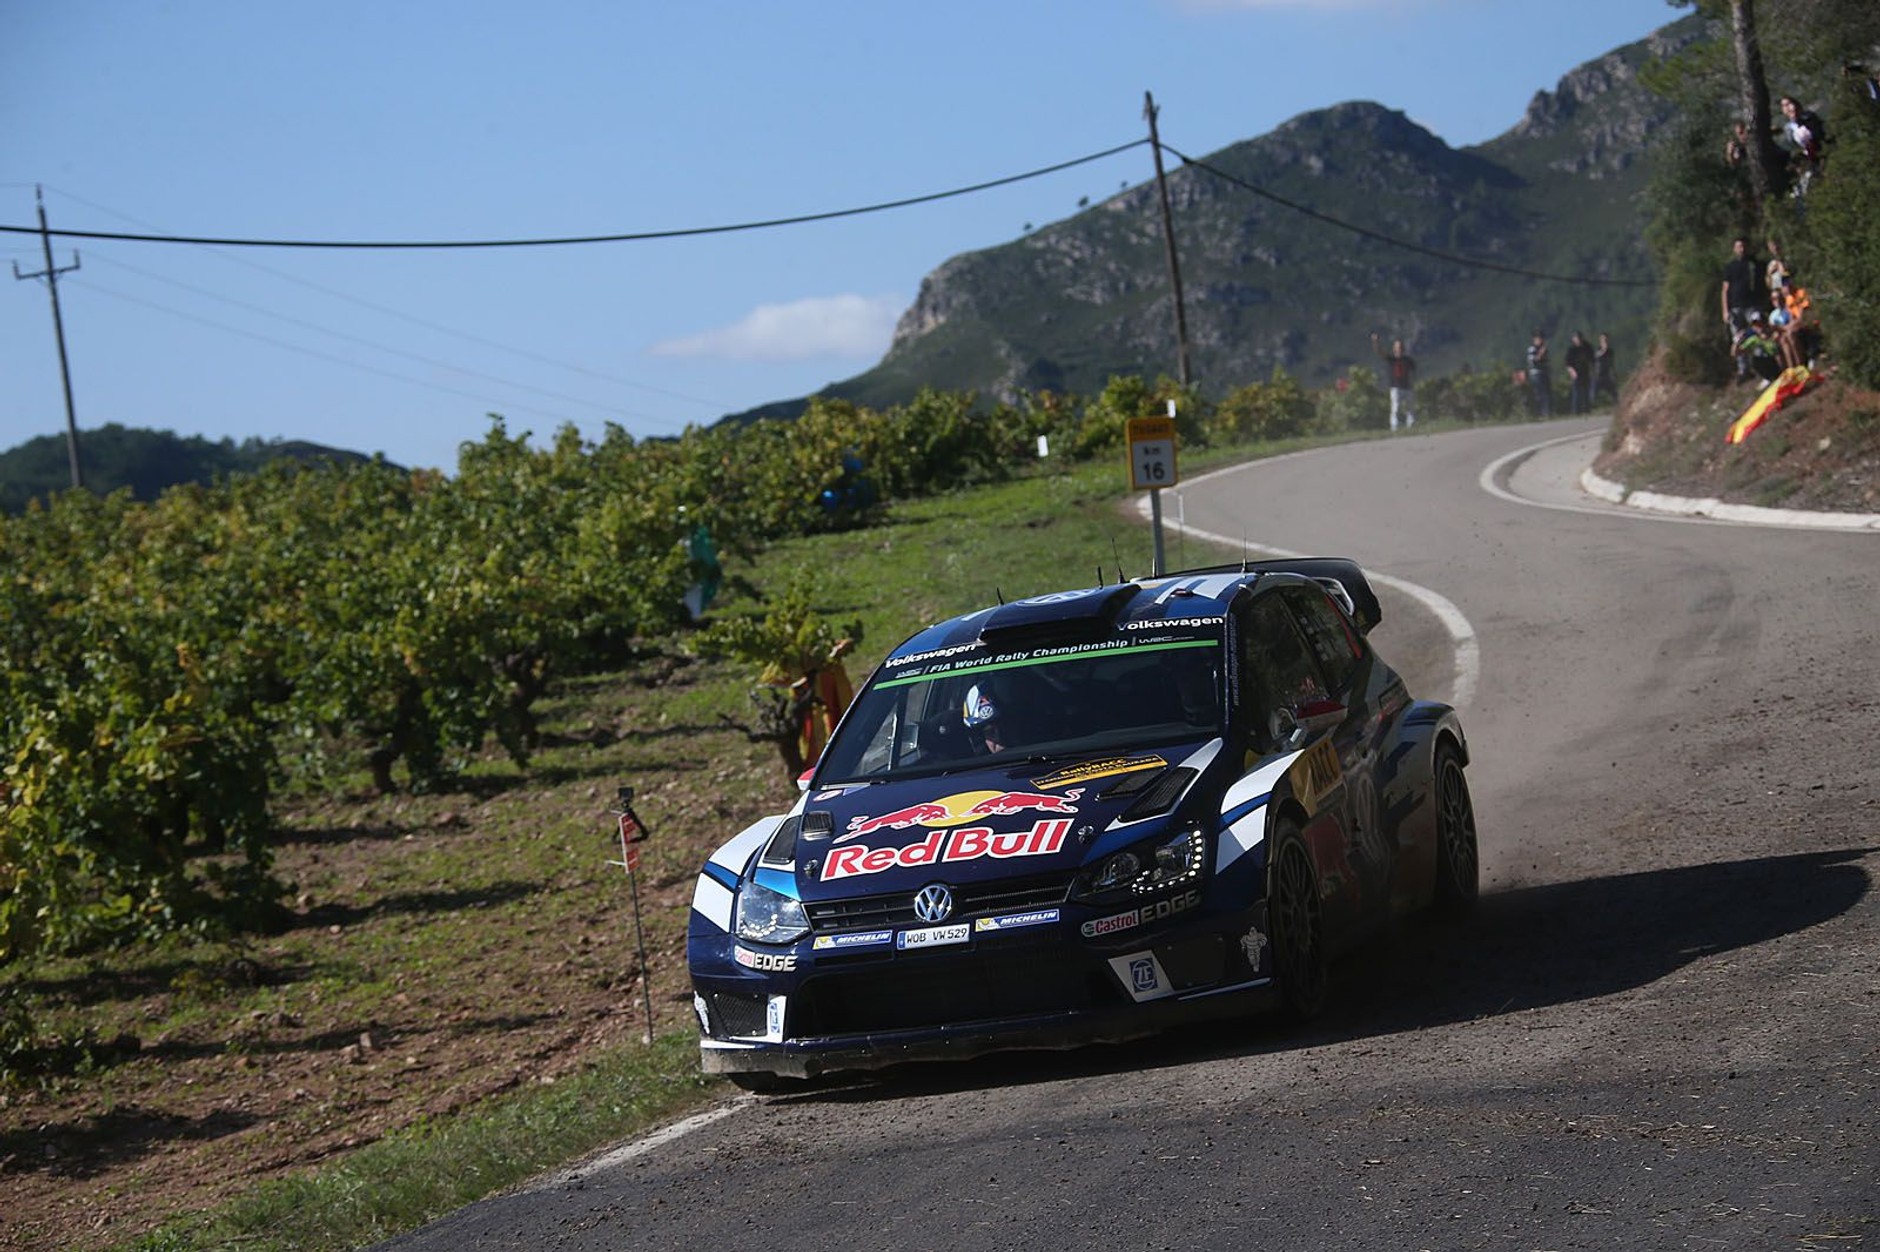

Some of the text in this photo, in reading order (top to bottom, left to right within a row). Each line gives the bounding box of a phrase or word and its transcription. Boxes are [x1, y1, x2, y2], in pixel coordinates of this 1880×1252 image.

[1143, 462, 1165, 481] 16
[1117, 617, 1224, 631] Volkswagen
[885, 644, 976, 669] Volkswagen
[930, 662, 951, 673] FIA
[955, 655, 992, 669] World
[995, 651, 1029, 663] Rally
[1032, 639, 1128, 657] Championship
[822, 819, 1073, 880] Red Bull
[1000, 911, 1057, 927] MICHELIN
[1095, 889, 1199, 934] Castrol EDGE
[837, 932, 890, 944] MICHELIN
[906, 932, 927, 944] WOB
[754, 952, 799, 972] EDGE
